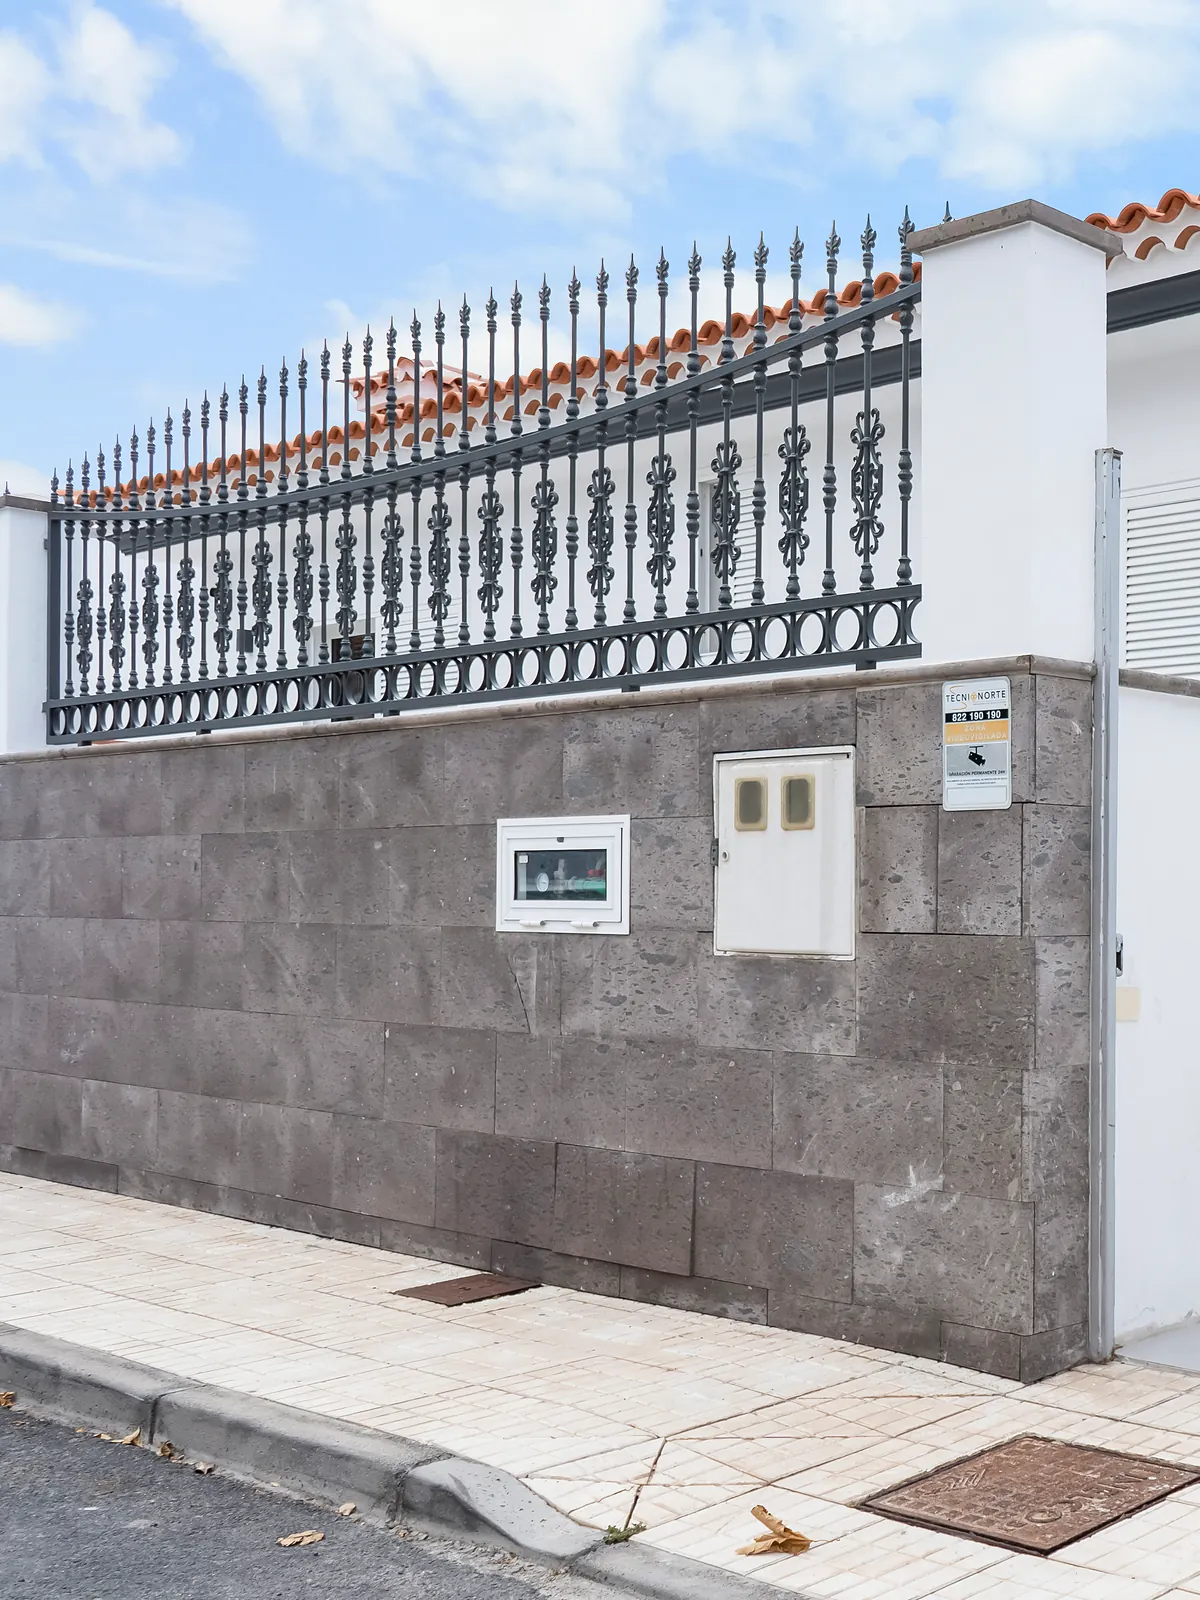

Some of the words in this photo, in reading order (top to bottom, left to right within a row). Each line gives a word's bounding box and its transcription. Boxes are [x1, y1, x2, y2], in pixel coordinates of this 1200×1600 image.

[952, 713, 967, 722] 822
[969, 711, 984, 721] 190
[986, 710, 1001, 719] 190
